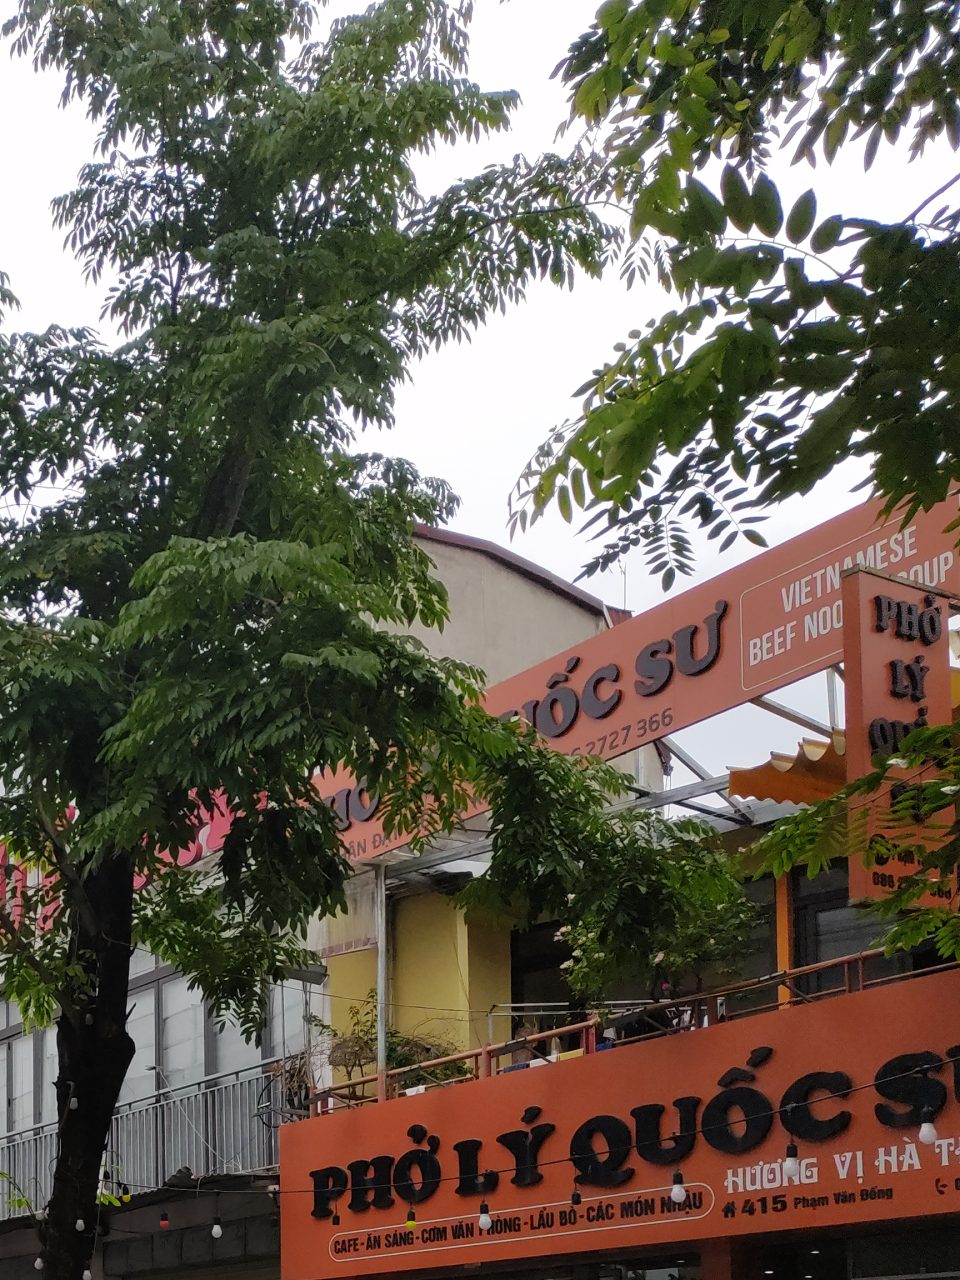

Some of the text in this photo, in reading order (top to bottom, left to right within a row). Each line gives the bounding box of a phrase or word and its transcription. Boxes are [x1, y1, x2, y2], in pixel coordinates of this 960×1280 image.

[781, 525, 917, 613] VIETNAMESE
[634, 599, 729, 697] SƯ
[749, 620, 797, 666] BEEF
[804, 600, 844, 642] NOO
[873, 593, 942, 646] PHỞ
[890, 655, 930, 702] LÝ
[636, 707, 673, 738] 366
[309, 1043, 960, 1219] PHỞ LÝ QUỐC S
[724, 1136, 960, 1194] HƯƠNG VỊ HÀ T
[334, 1237, 359, 1254] CAFE
[366, 1233, 381, 1251] ĂN
[385, 1229, 414, 1248] SÁNG
[421, 1225, 448, 1244] CƠM
[451, 1220, 474, 1239] VĂN
[529, 1205, 554, 1230] LẨU
[559, 1207, 577, 1227] BÒ
[586, 1201, 615, 1223] CÁC
[620, 1195, 656, 1219] MÓN
[741, 1194, 788, 1217] 415
[793, 1194, 829, 1211] Phạm
[833, 1191, 856, 1204] Văn
